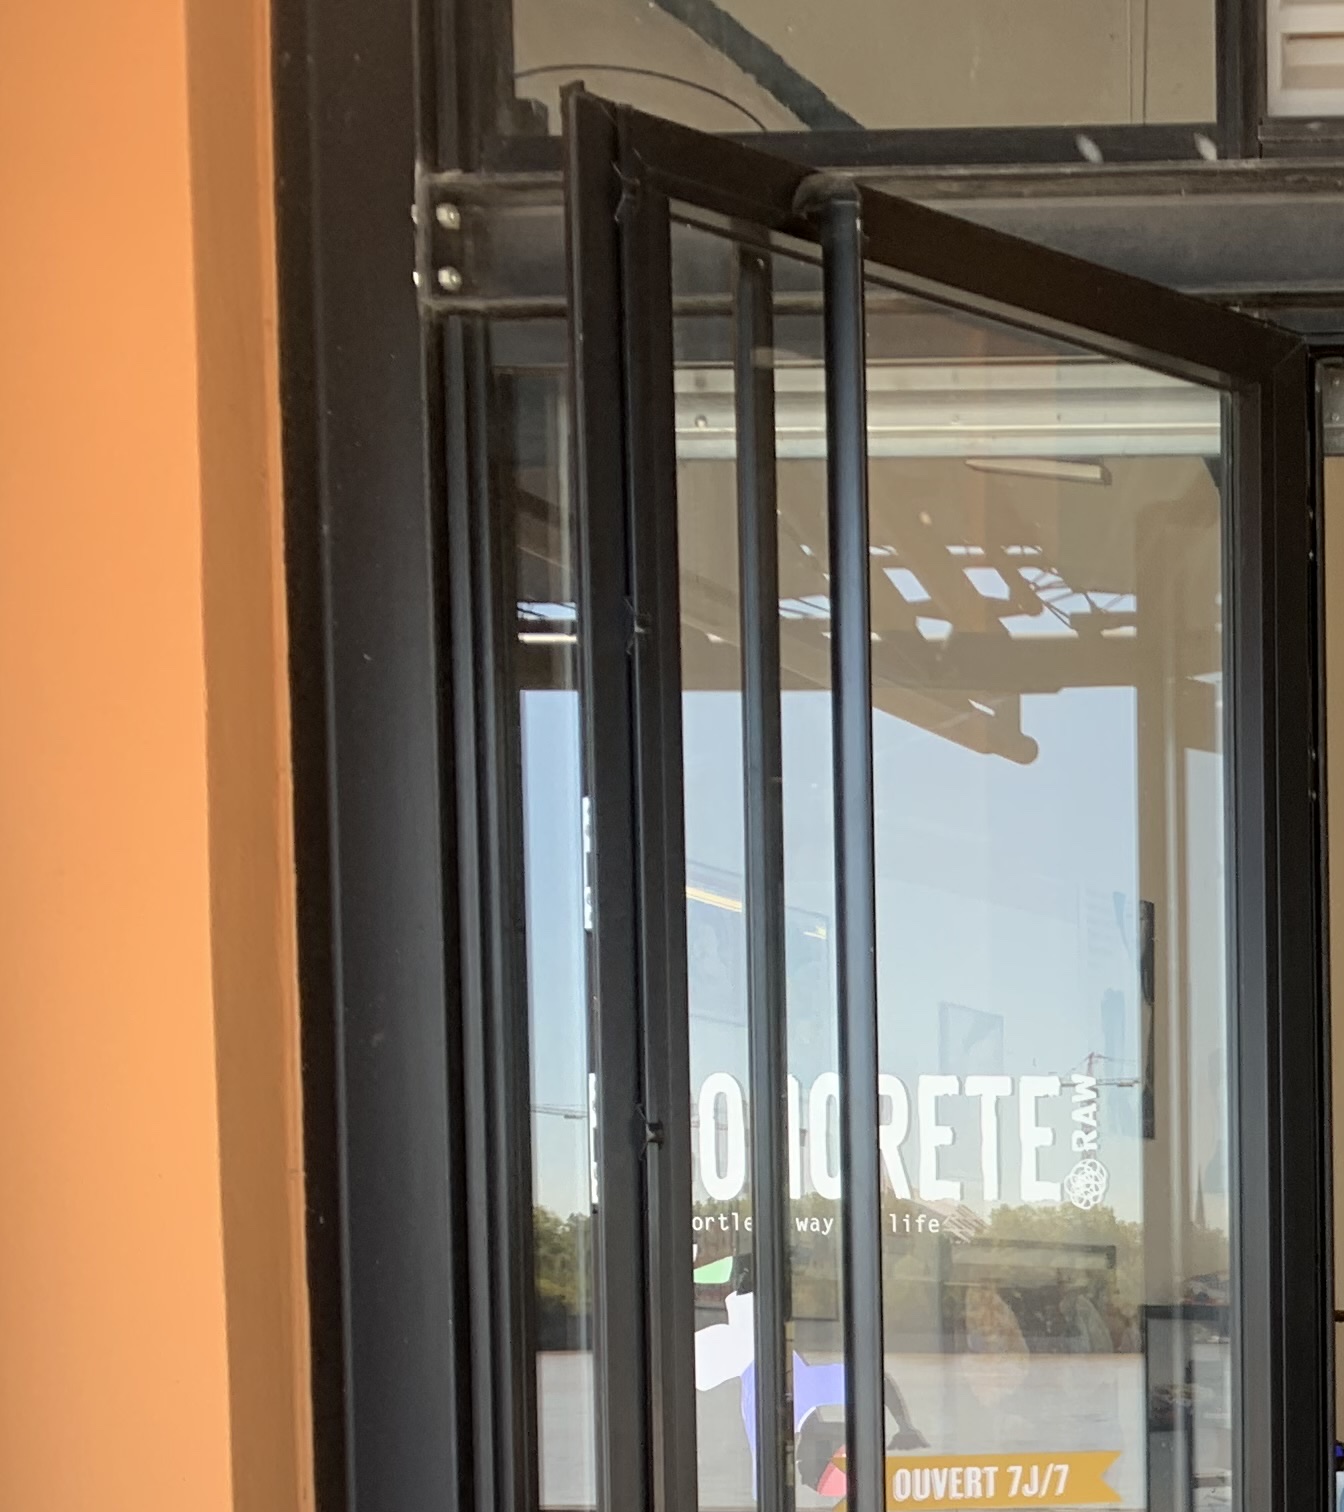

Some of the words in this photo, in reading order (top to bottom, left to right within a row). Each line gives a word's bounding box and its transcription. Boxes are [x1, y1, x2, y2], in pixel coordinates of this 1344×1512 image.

[1071, 1073, 1099, 1152] RAW
[795, 1215, 835, 1234] way
[889, 1213, 941, 1233] life
[892, 1465, 999, 1502] OUVERT
[1006, 1462, 1070, 1499] 7J/7
